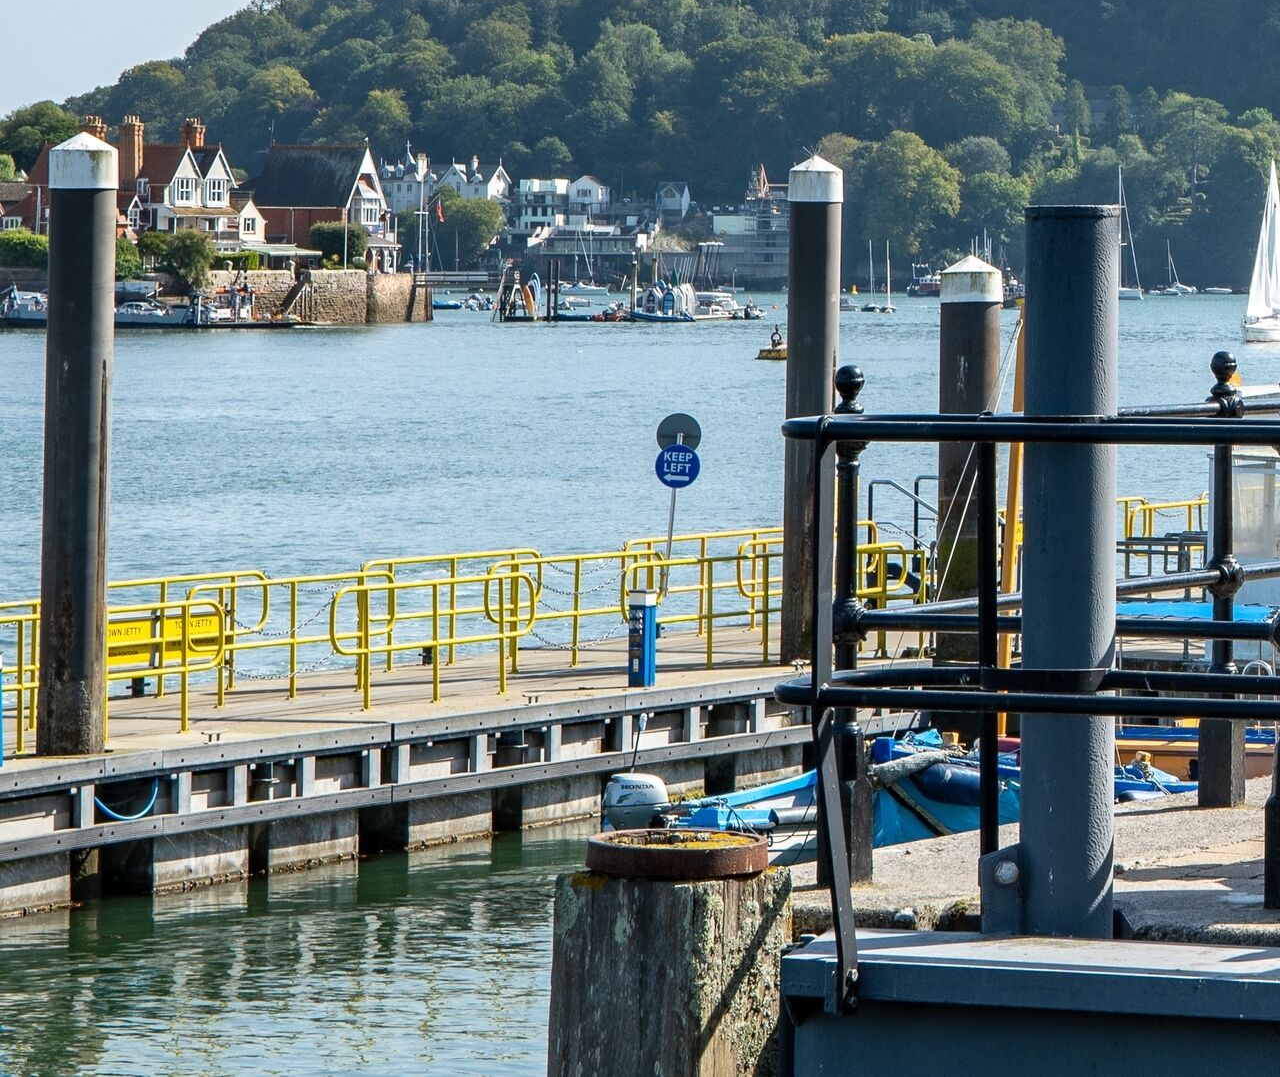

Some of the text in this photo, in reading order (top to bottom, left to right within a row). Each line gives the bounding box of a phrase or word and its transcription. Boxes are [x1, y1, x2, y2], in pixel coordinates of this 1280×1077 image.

[663, 451, 693, 462] KEEP
[663, 463, 692, 473] LEFT
[175, 619, 212, 630] TON JETTY
[123, 627, 142, 636] JETTY
